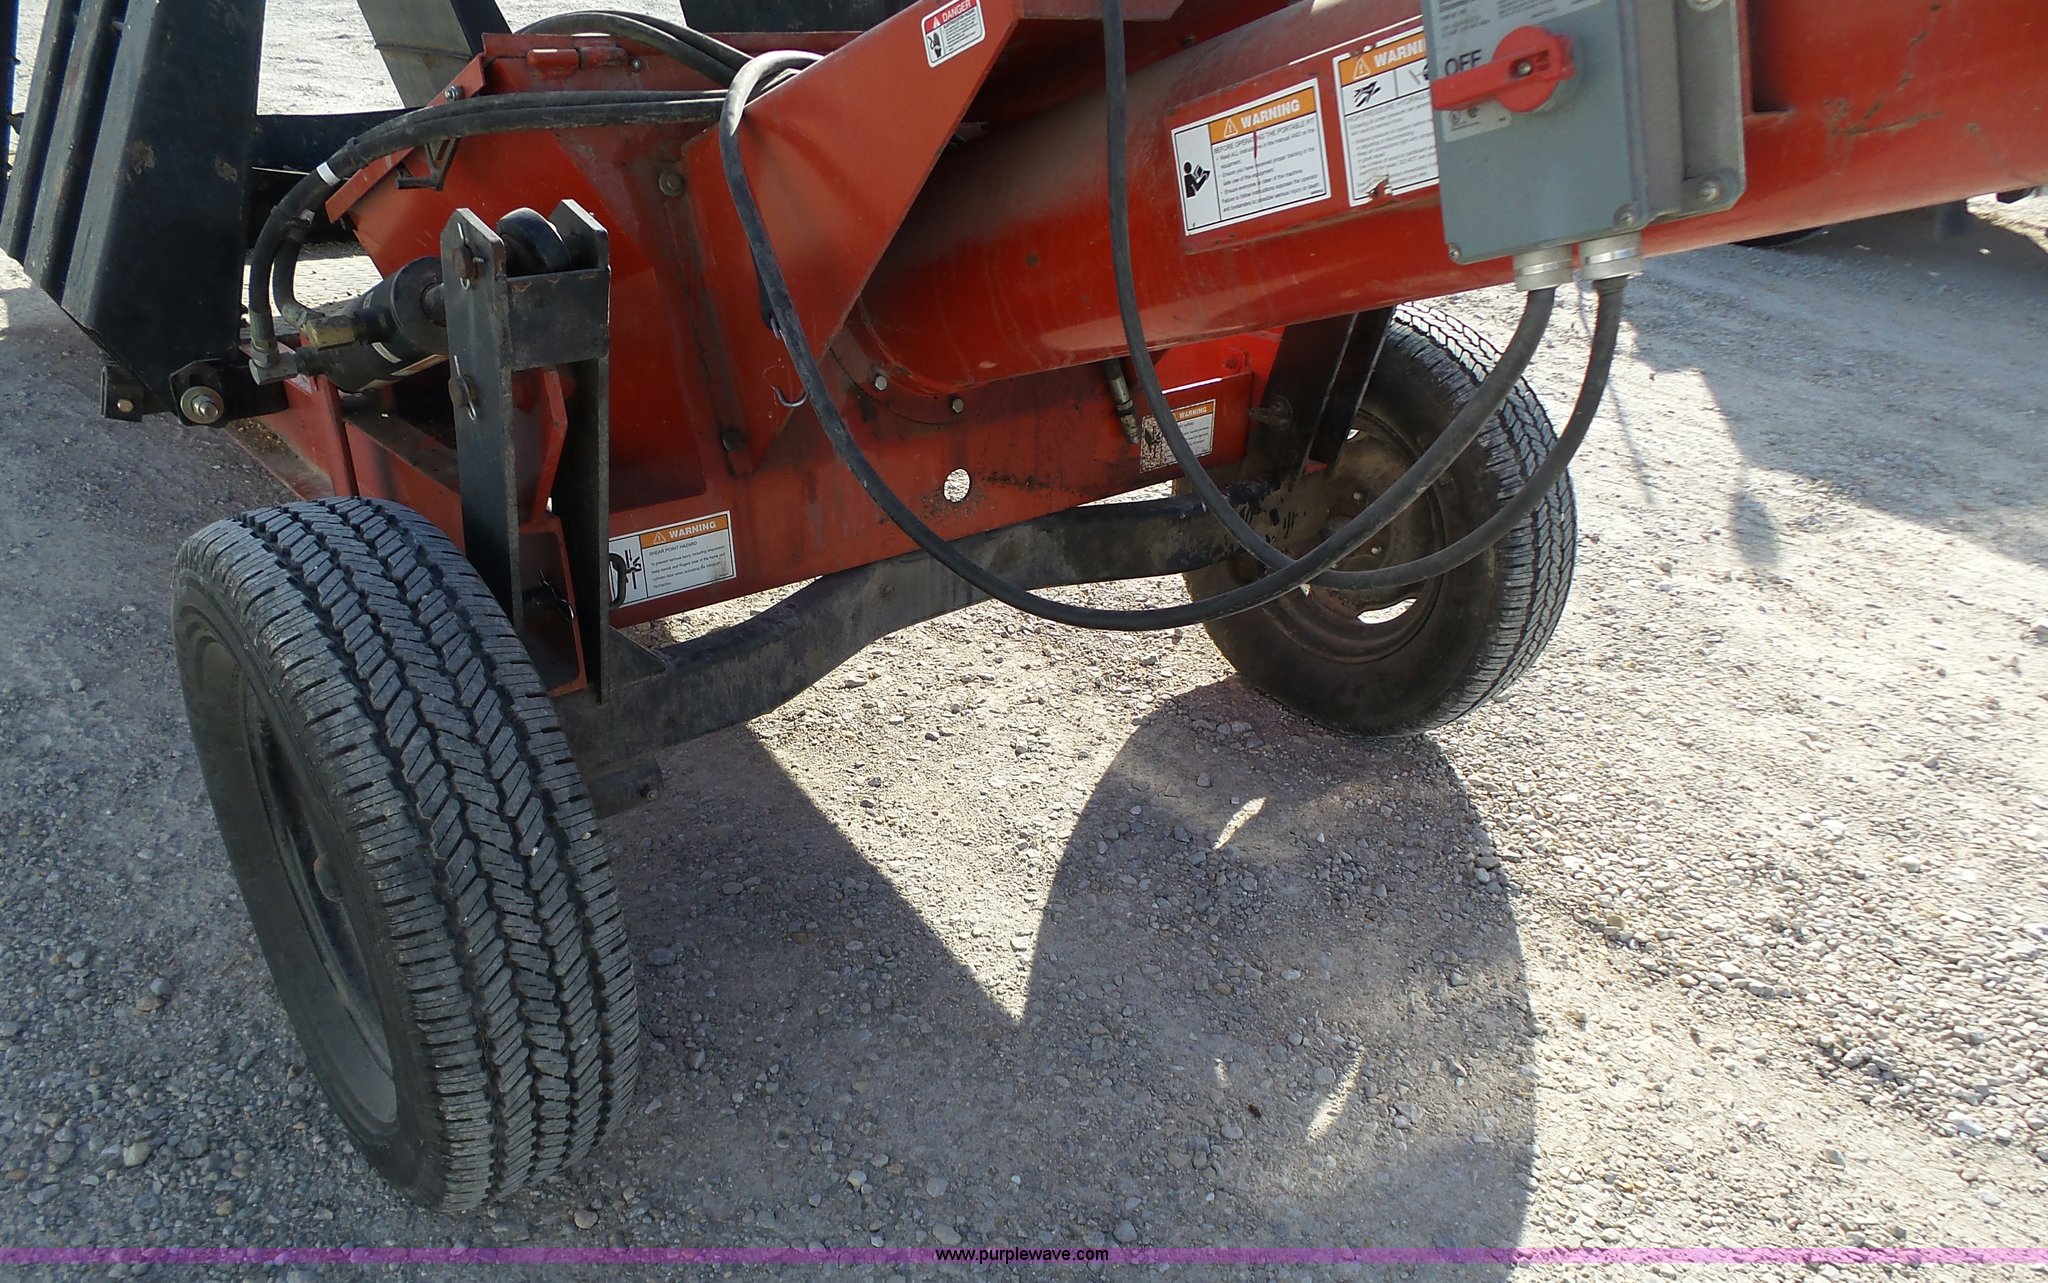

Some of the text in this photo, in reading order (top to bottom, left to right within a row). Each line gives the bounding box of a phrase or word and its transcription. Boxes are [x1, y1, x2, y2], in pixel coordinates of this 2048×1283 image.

[942, 1, 971, 21] DANGER
[1444, 49, 1482, 75] OFF
[1240, 99, 1300, 129] WARNING
[1180, 406, 1207, 419] WARNING
[669, 521, 717, 539] WARNING
